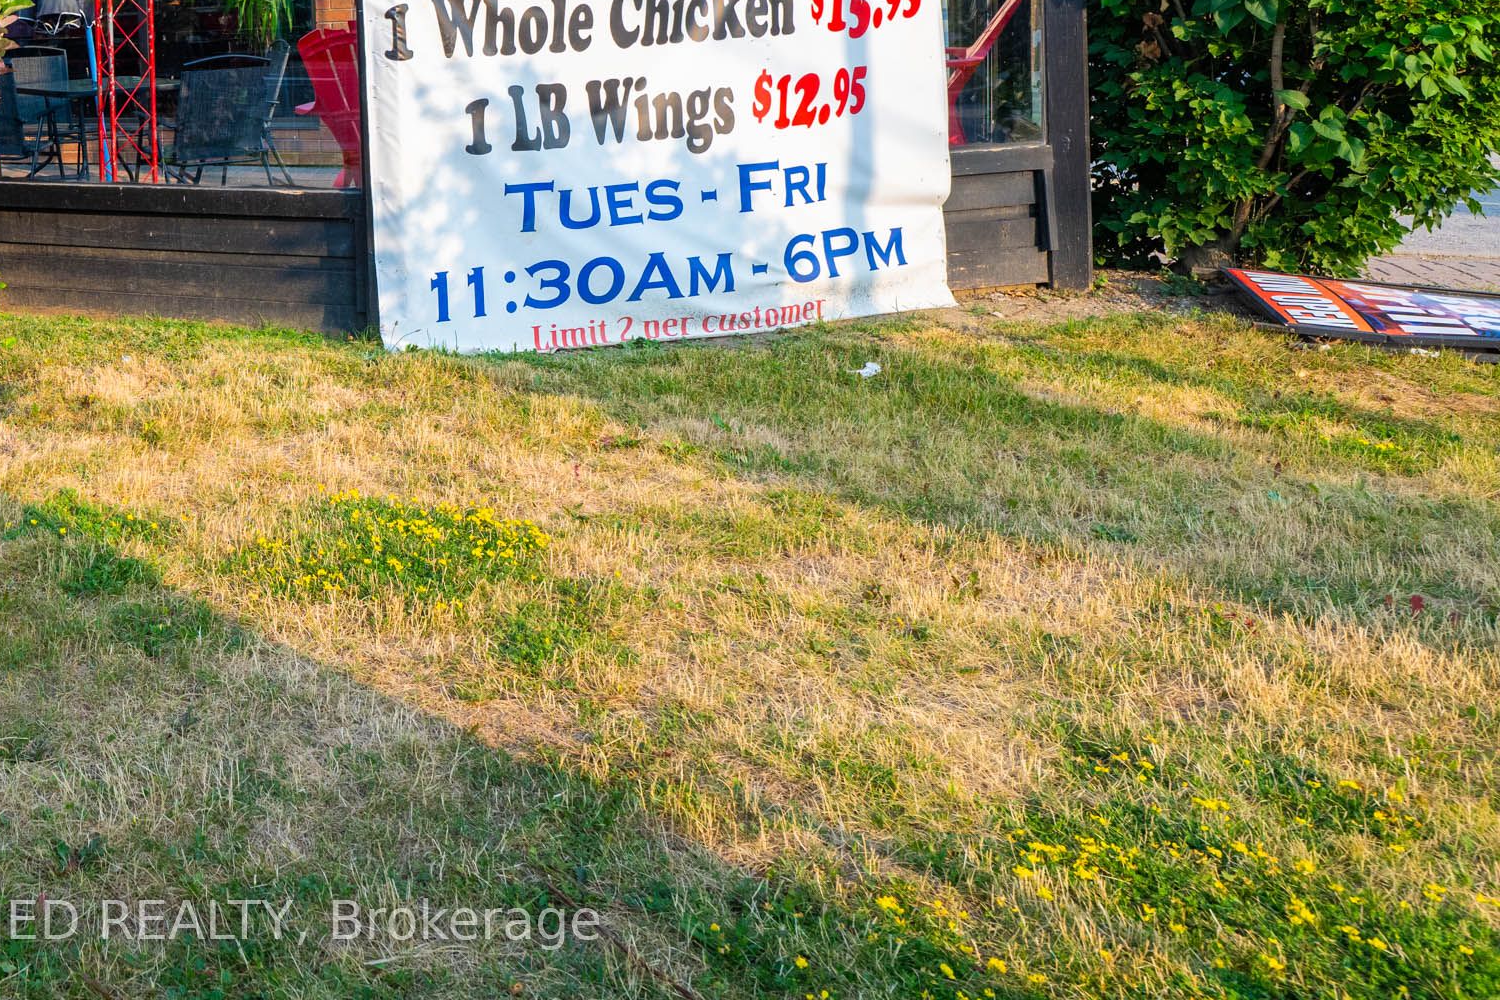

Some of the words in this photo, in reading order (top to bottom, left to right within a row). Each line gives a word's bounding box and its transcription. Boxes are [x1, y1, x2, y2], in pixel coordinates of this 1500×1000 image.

[383, 2, 414, 61] 1
[465, 98, 492, 155] 1
[507, 83, 571, 152] LB
[585, 75, 736, 155] Wings
[752, 66, 867, 130] $12.95
[700, 189, 718, 201] -
[430, 251, 736, 323] 11:30AM
[751, 263, 769, 275] -
[782, 226, 909, 284] 6PM
[532, 319, 608, 351] Limit
[617, 316, 632, 341] 2
[701, 299, 826, 333] customer
[1270, 295, 1359, 330] OPEN
